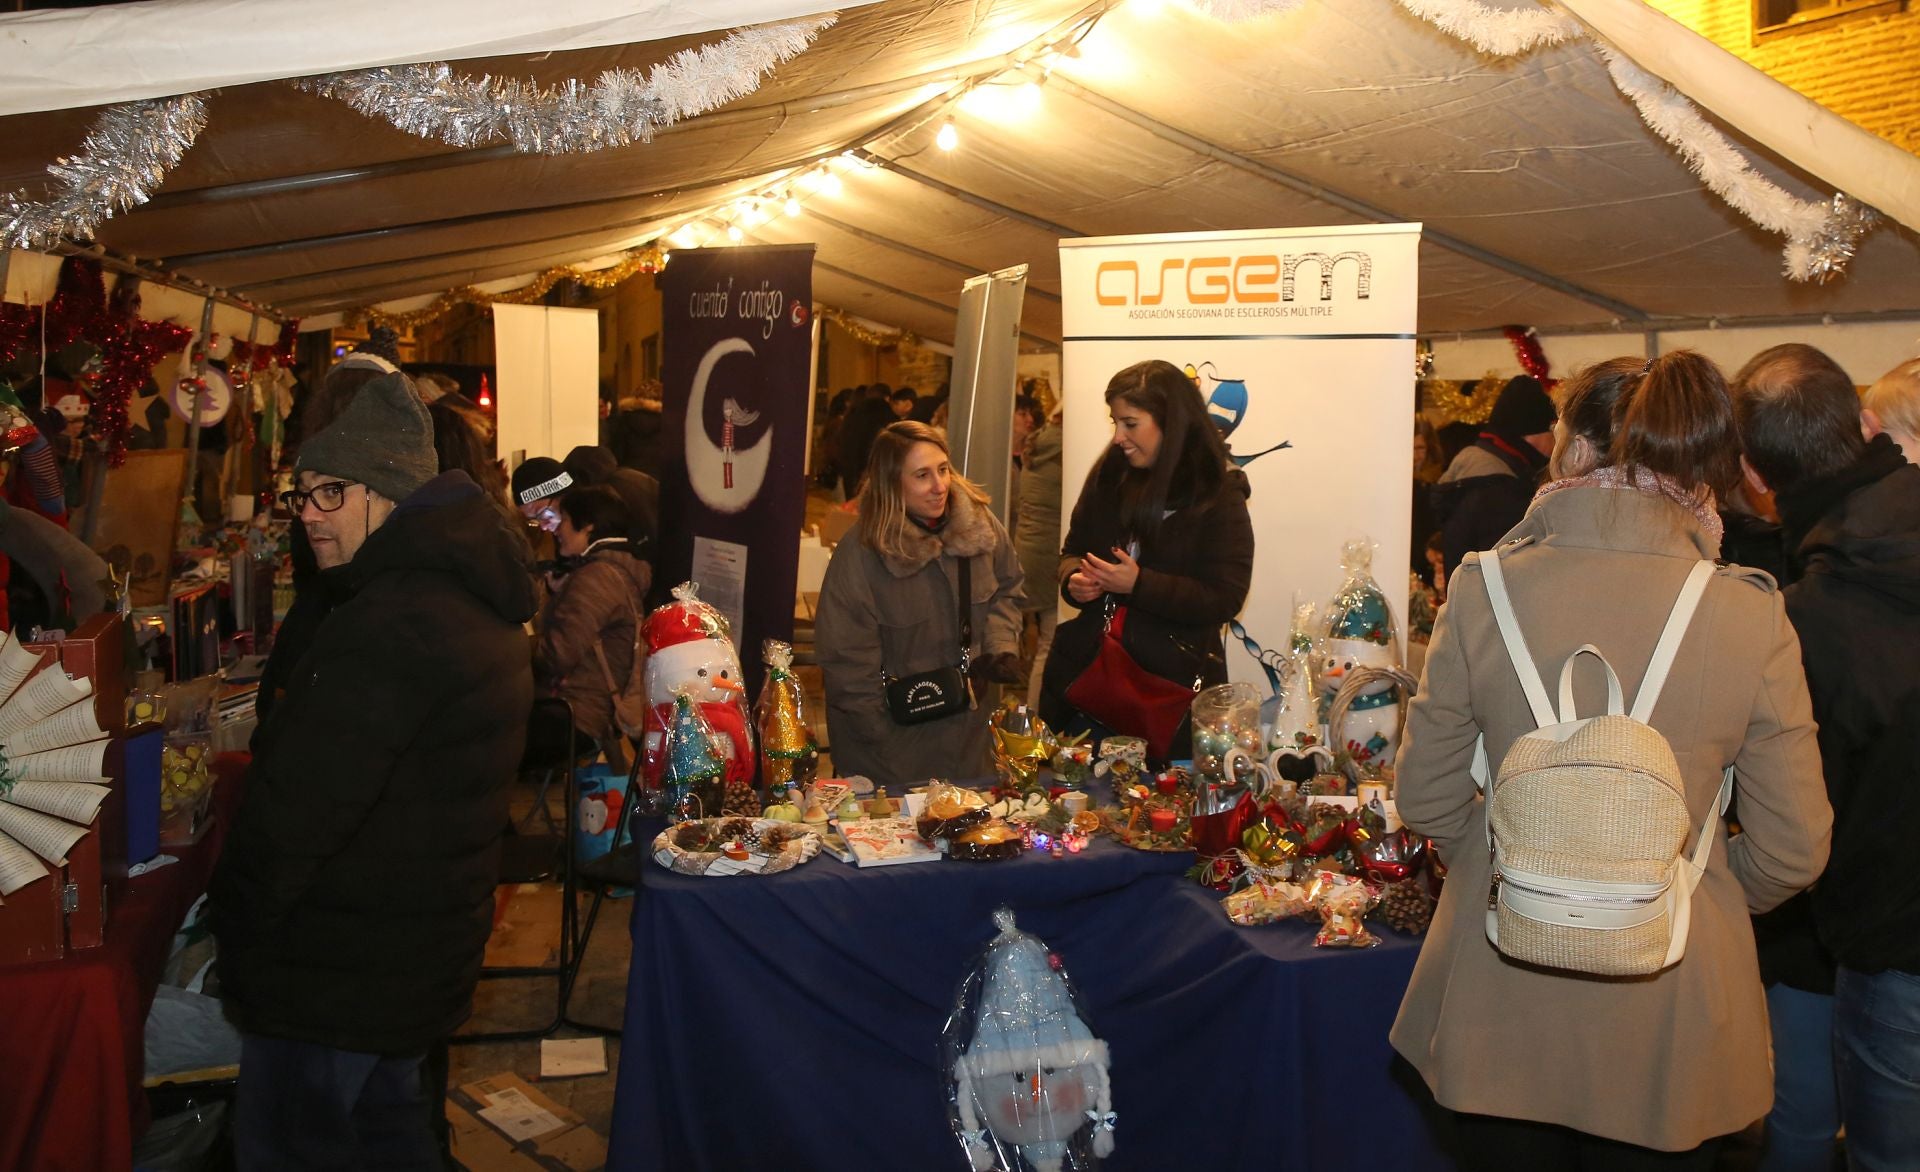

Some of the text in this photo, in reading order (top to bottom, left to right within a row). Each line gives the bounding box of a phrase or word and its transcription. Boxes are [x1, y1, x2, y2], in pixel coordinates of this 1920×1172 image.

[738, 280, 783, 340] contigo
[1128, 305, 1334, 320] ASOCIACIÓN SEGOVIANA DE ESCLEROSIS MÚLTIPLE
[522, 479, 564, 502] BAD HAIR
